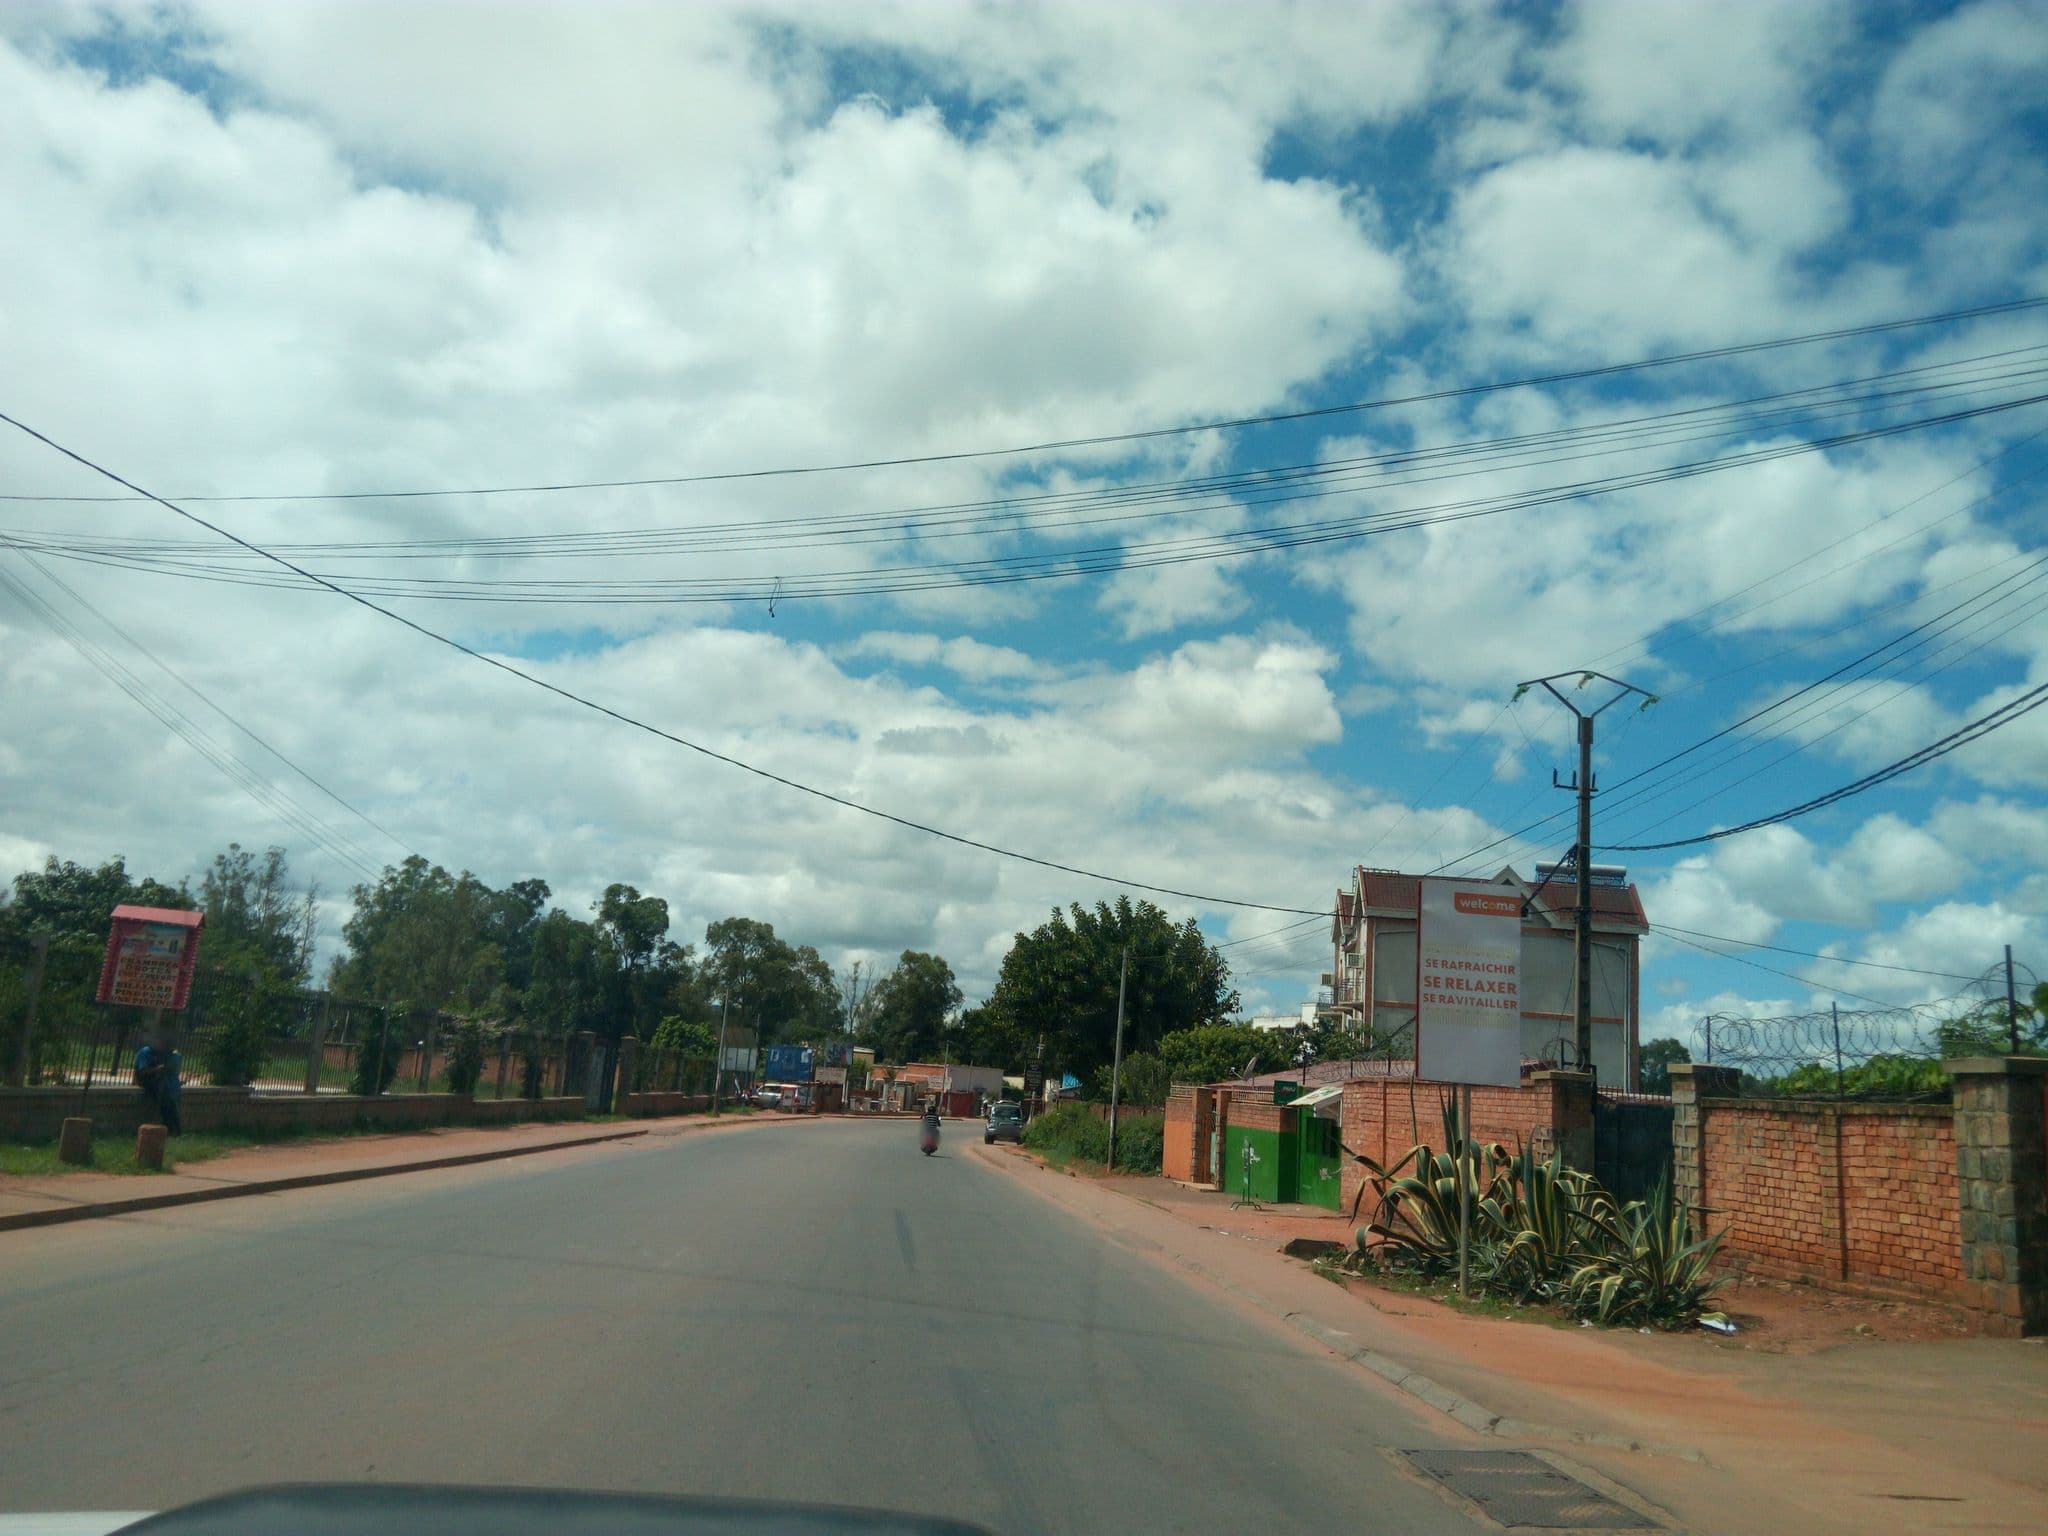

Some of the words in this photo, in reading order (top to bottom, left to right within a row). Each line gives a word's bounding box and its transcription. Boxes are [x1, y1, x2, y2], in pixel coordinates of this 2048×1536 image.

[1460, 899, 1517, 911] welcome
[1425, 959, 1438, 968] SE
[1441, 960, 1516, 974] RAFRAICHIR
[1424, 975, 1441, 988] SE
[1445, 977, 1517, 994] RELAXER
[1423, 993, 1436, 1002] SE
[1439, 995, 1518, 1009] RAVITAILLER
